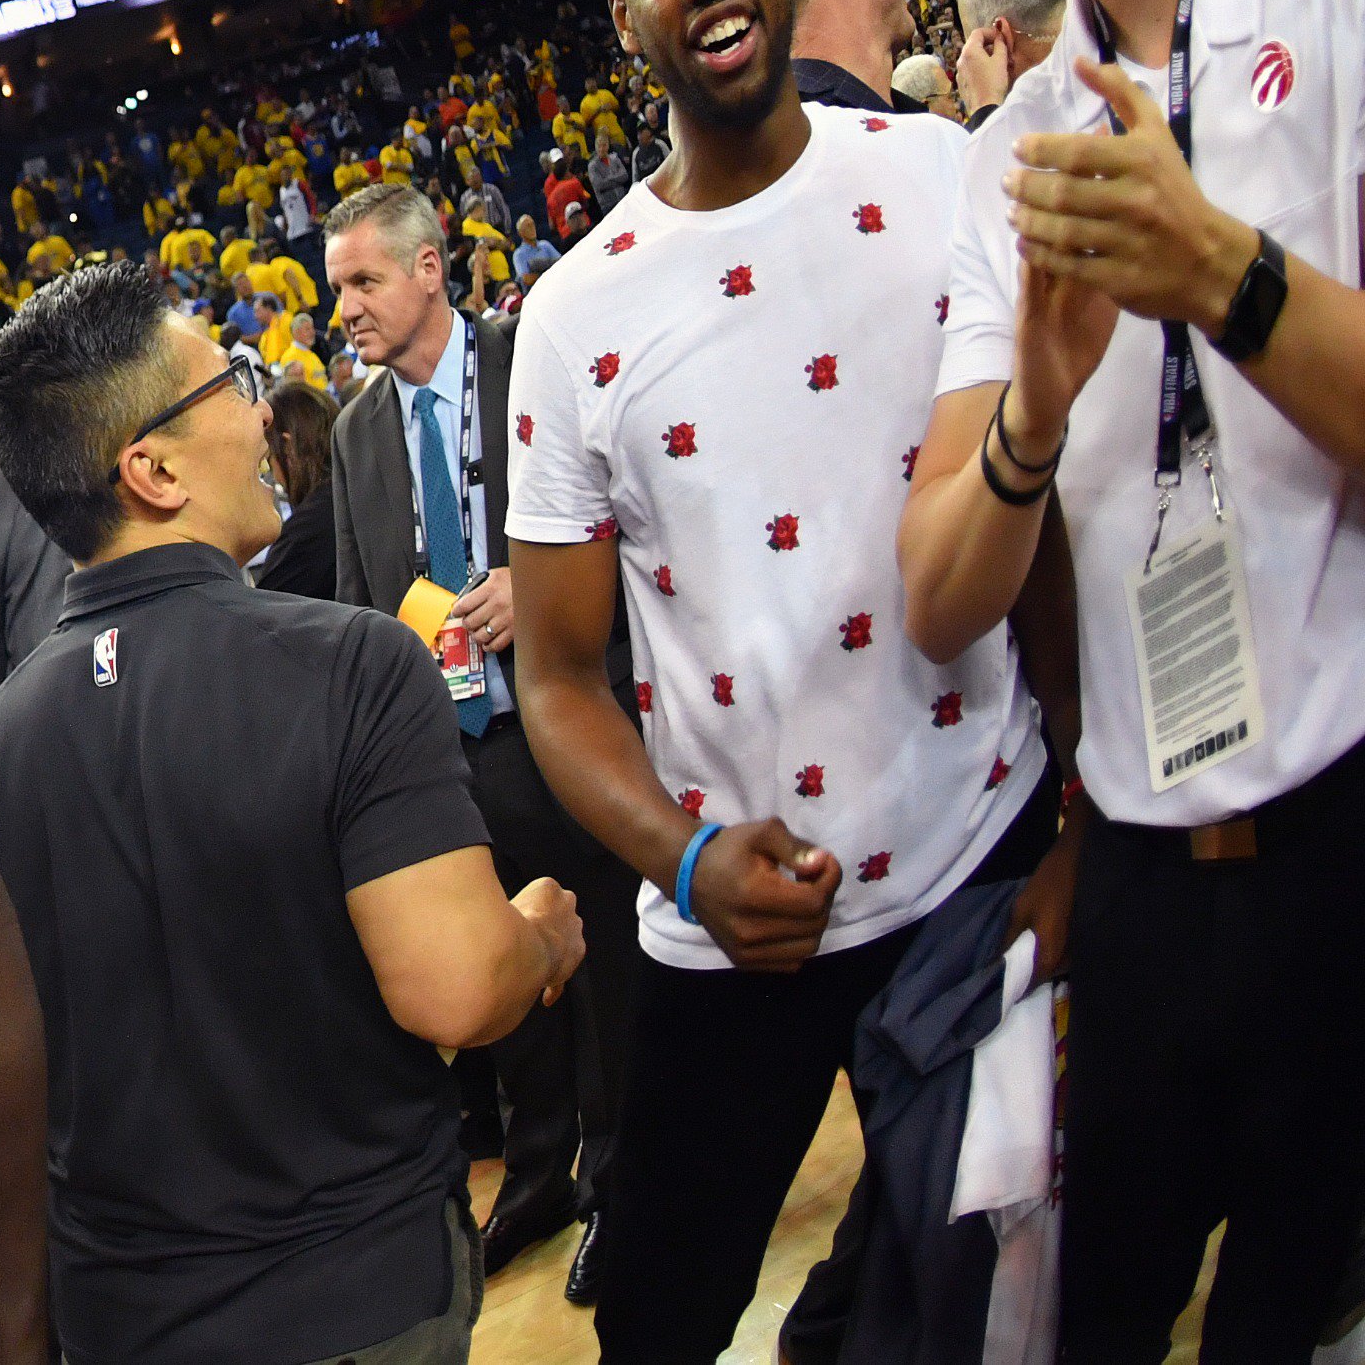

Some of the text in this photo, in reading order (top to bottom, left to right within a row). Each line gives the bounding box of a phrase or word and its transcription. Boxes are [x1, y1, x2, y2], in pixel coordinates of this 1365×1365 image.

[1171, 51, 1184, 105] NBA FINALS
[1163, 356, 1179, 413] NBA FINALS
